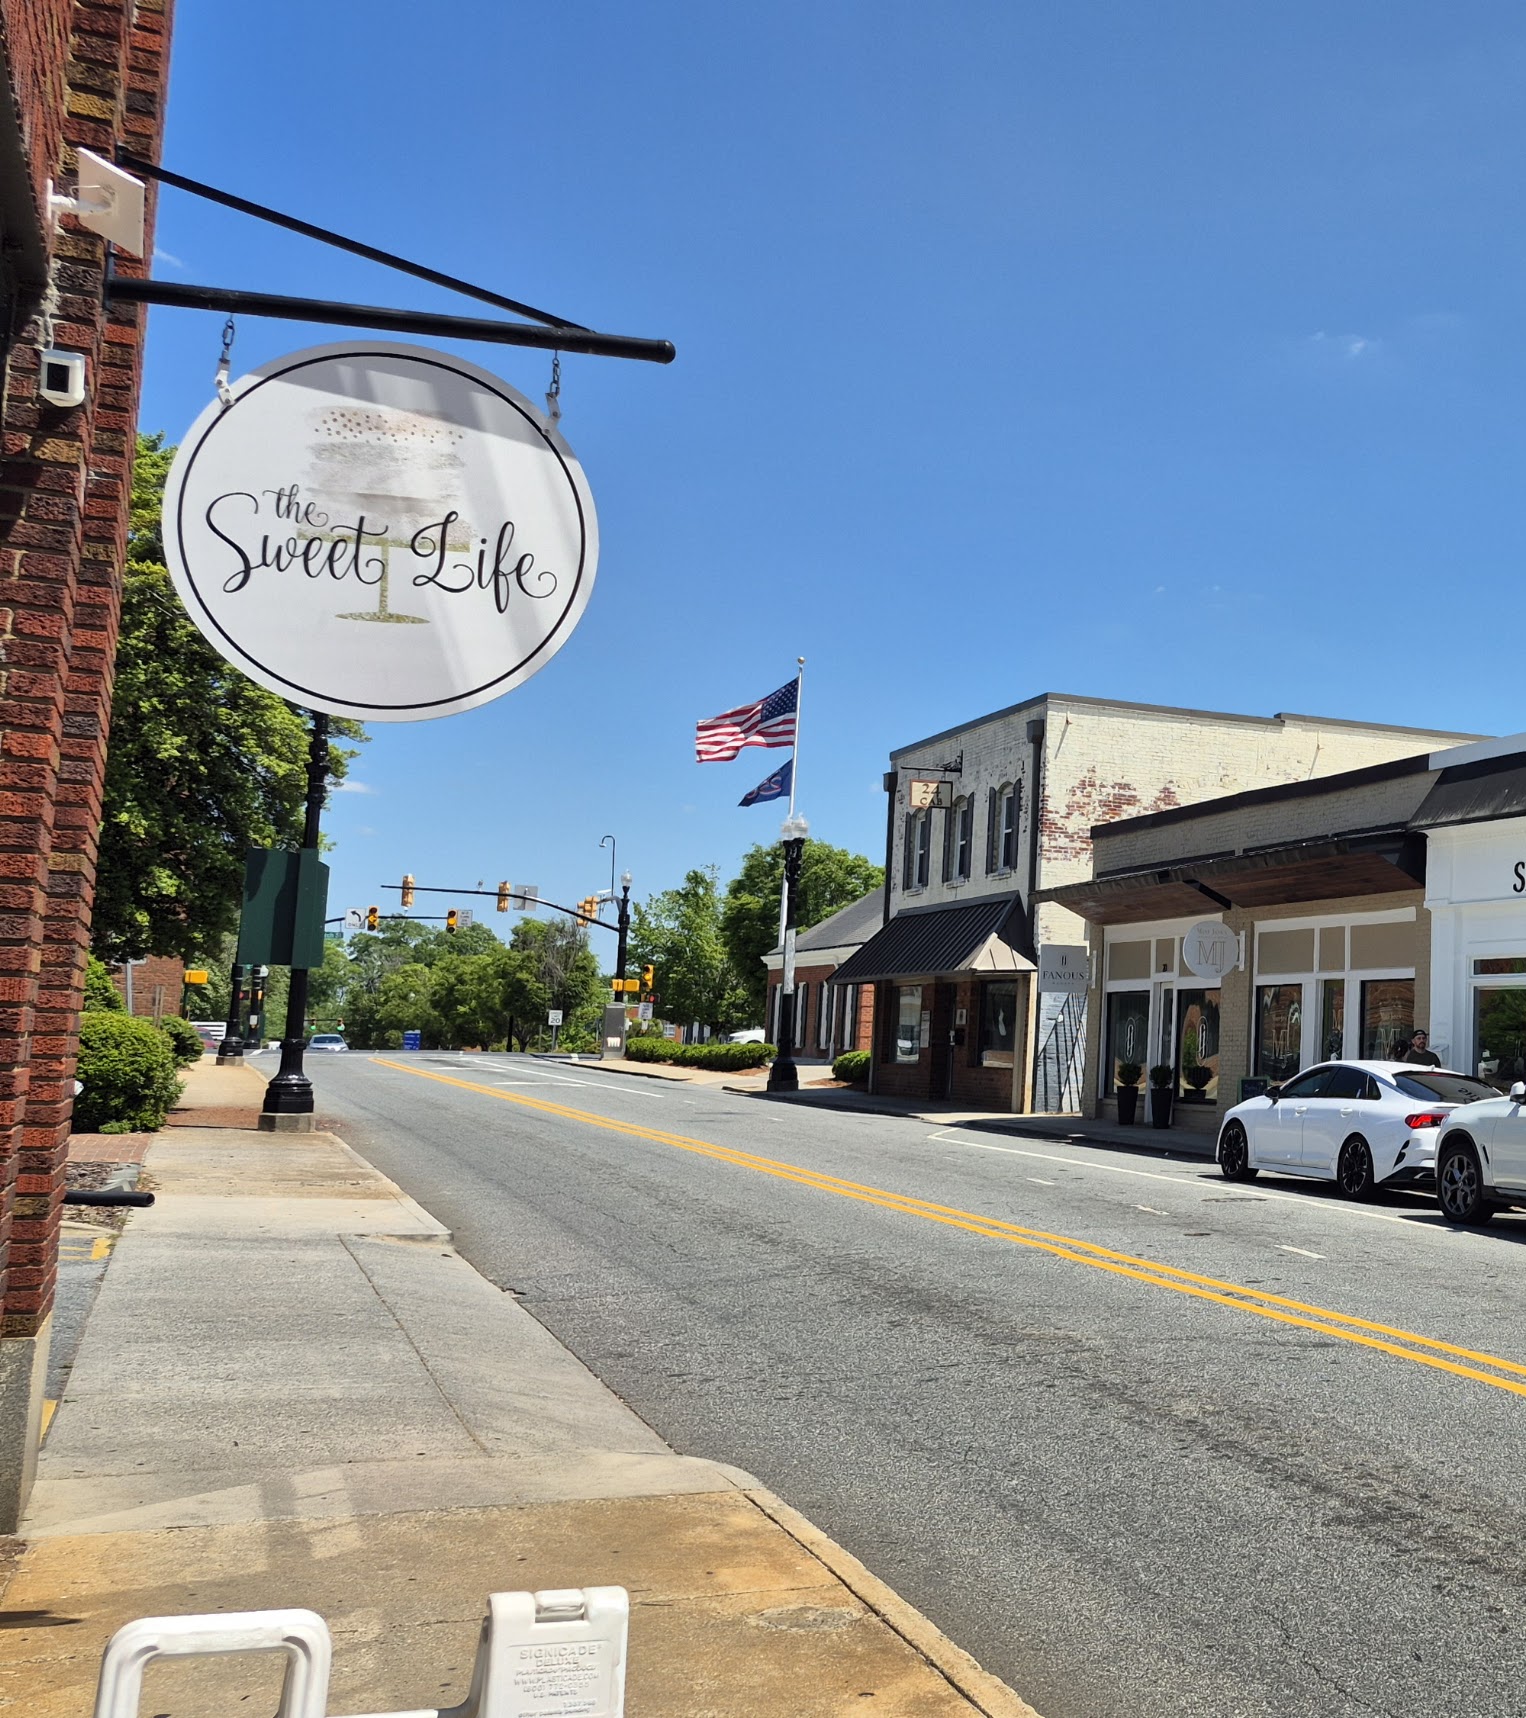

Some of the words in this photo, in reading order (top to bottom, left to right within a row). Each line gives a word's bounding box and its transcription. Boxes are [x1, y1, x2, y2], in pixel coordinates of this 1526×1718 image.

[262, 484, 329, 527] the
[206, 492, 389, 593] Sweet
[410, 511, 557, 614] Life
[922, 783, 941, 794] 24
[1196, 941, 1226, 973] MJ
[1043, 970, 1085, 981] FANOUS
[536, 1658, 580, 1668] DELUXE
